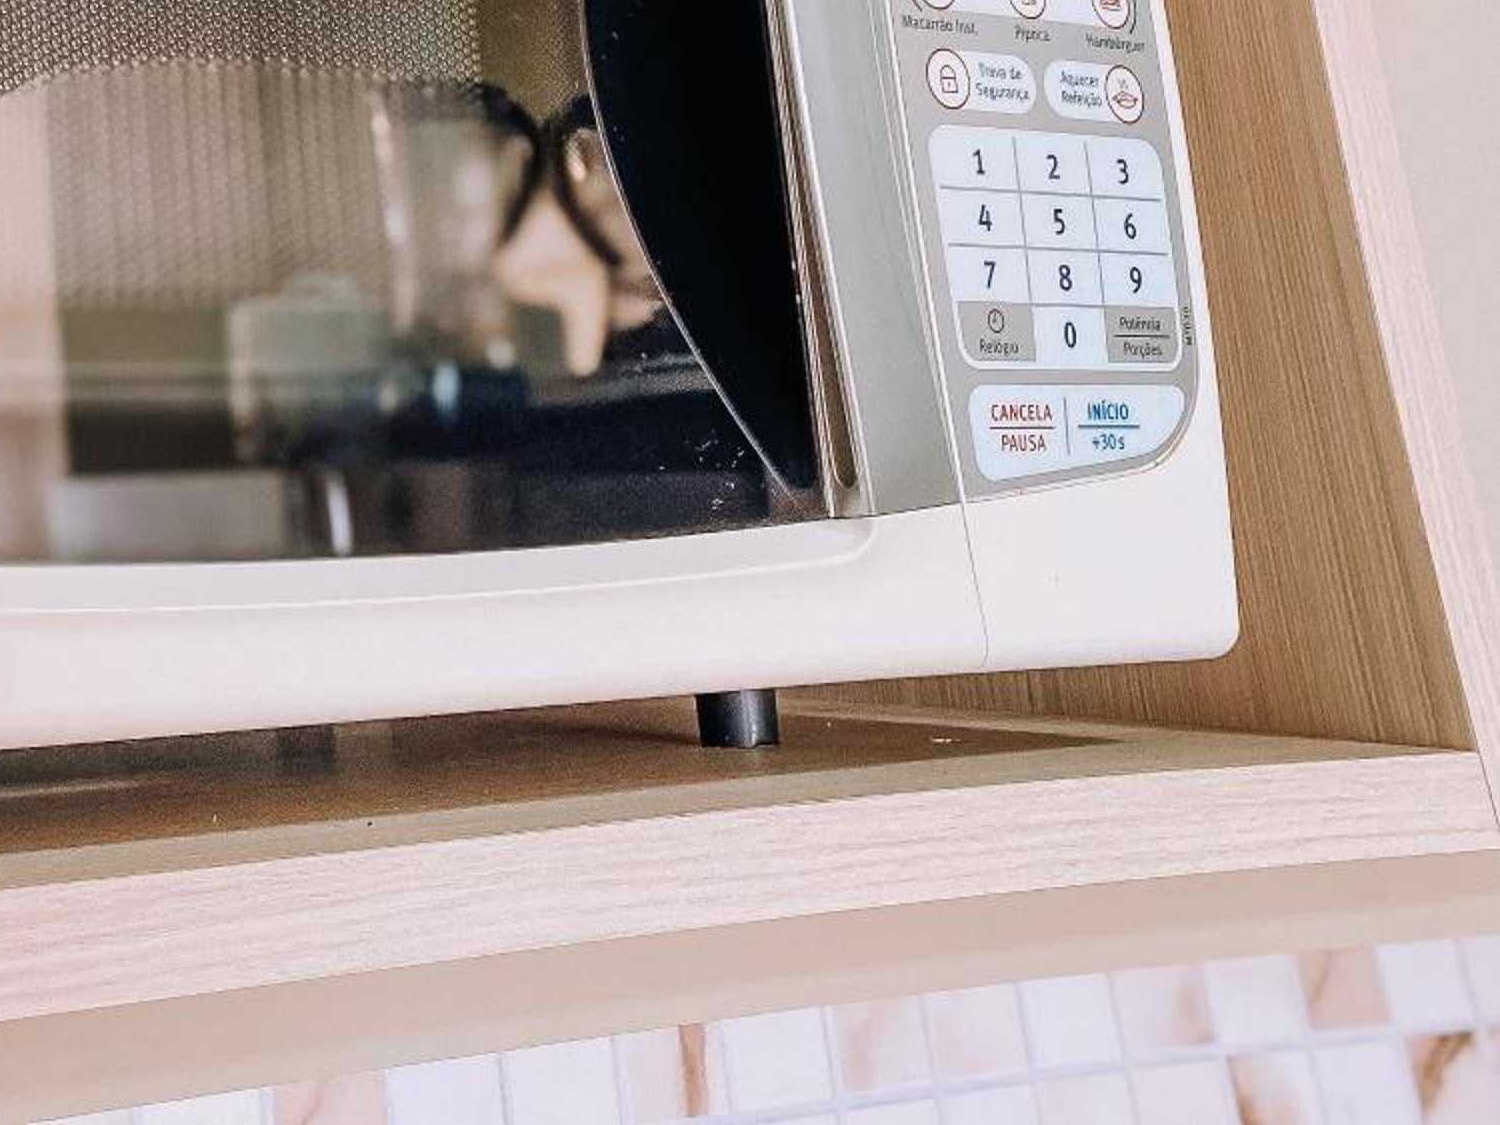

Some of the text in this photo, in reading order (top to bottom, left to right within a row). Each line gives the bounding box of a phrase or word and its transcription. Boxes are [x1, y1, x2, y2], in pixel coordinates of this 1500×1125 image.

[902, 15, 954, 32] Macarrão
[1015, 25, 1051, 43] Pipoca
[978, 62, 1023, 80] Trava de
[1060, 70, 1100, 88] Aquecer
[975, 82, 1030, 101] Segurança
[1061, 90, 1103, 108] Refeição
[972, 149, 986, 175] 1
[1046, 154, 1061, 180] 2
[1116, 159, 1130, 185] 3
[978, 204, 993, 232] 4
[1053, 208, 1066, 235] 5
[1124, 213, 1137, 240] 6
[983, 261, 997, 289] 7
[1058, 264, 1073, 291] 8
[1129, 266, 1143, 294] 9
[978, 337, 1020, 355] Relógio
[1063, 322, 1078, 349] 0
[1123, 342, 1163, 359] Porções
[990, 403, 1053, 422] CANCELA
[1087, 399, 1129, 421] INÍCIO
[1001, 434, 1047, 453] PAUSA
